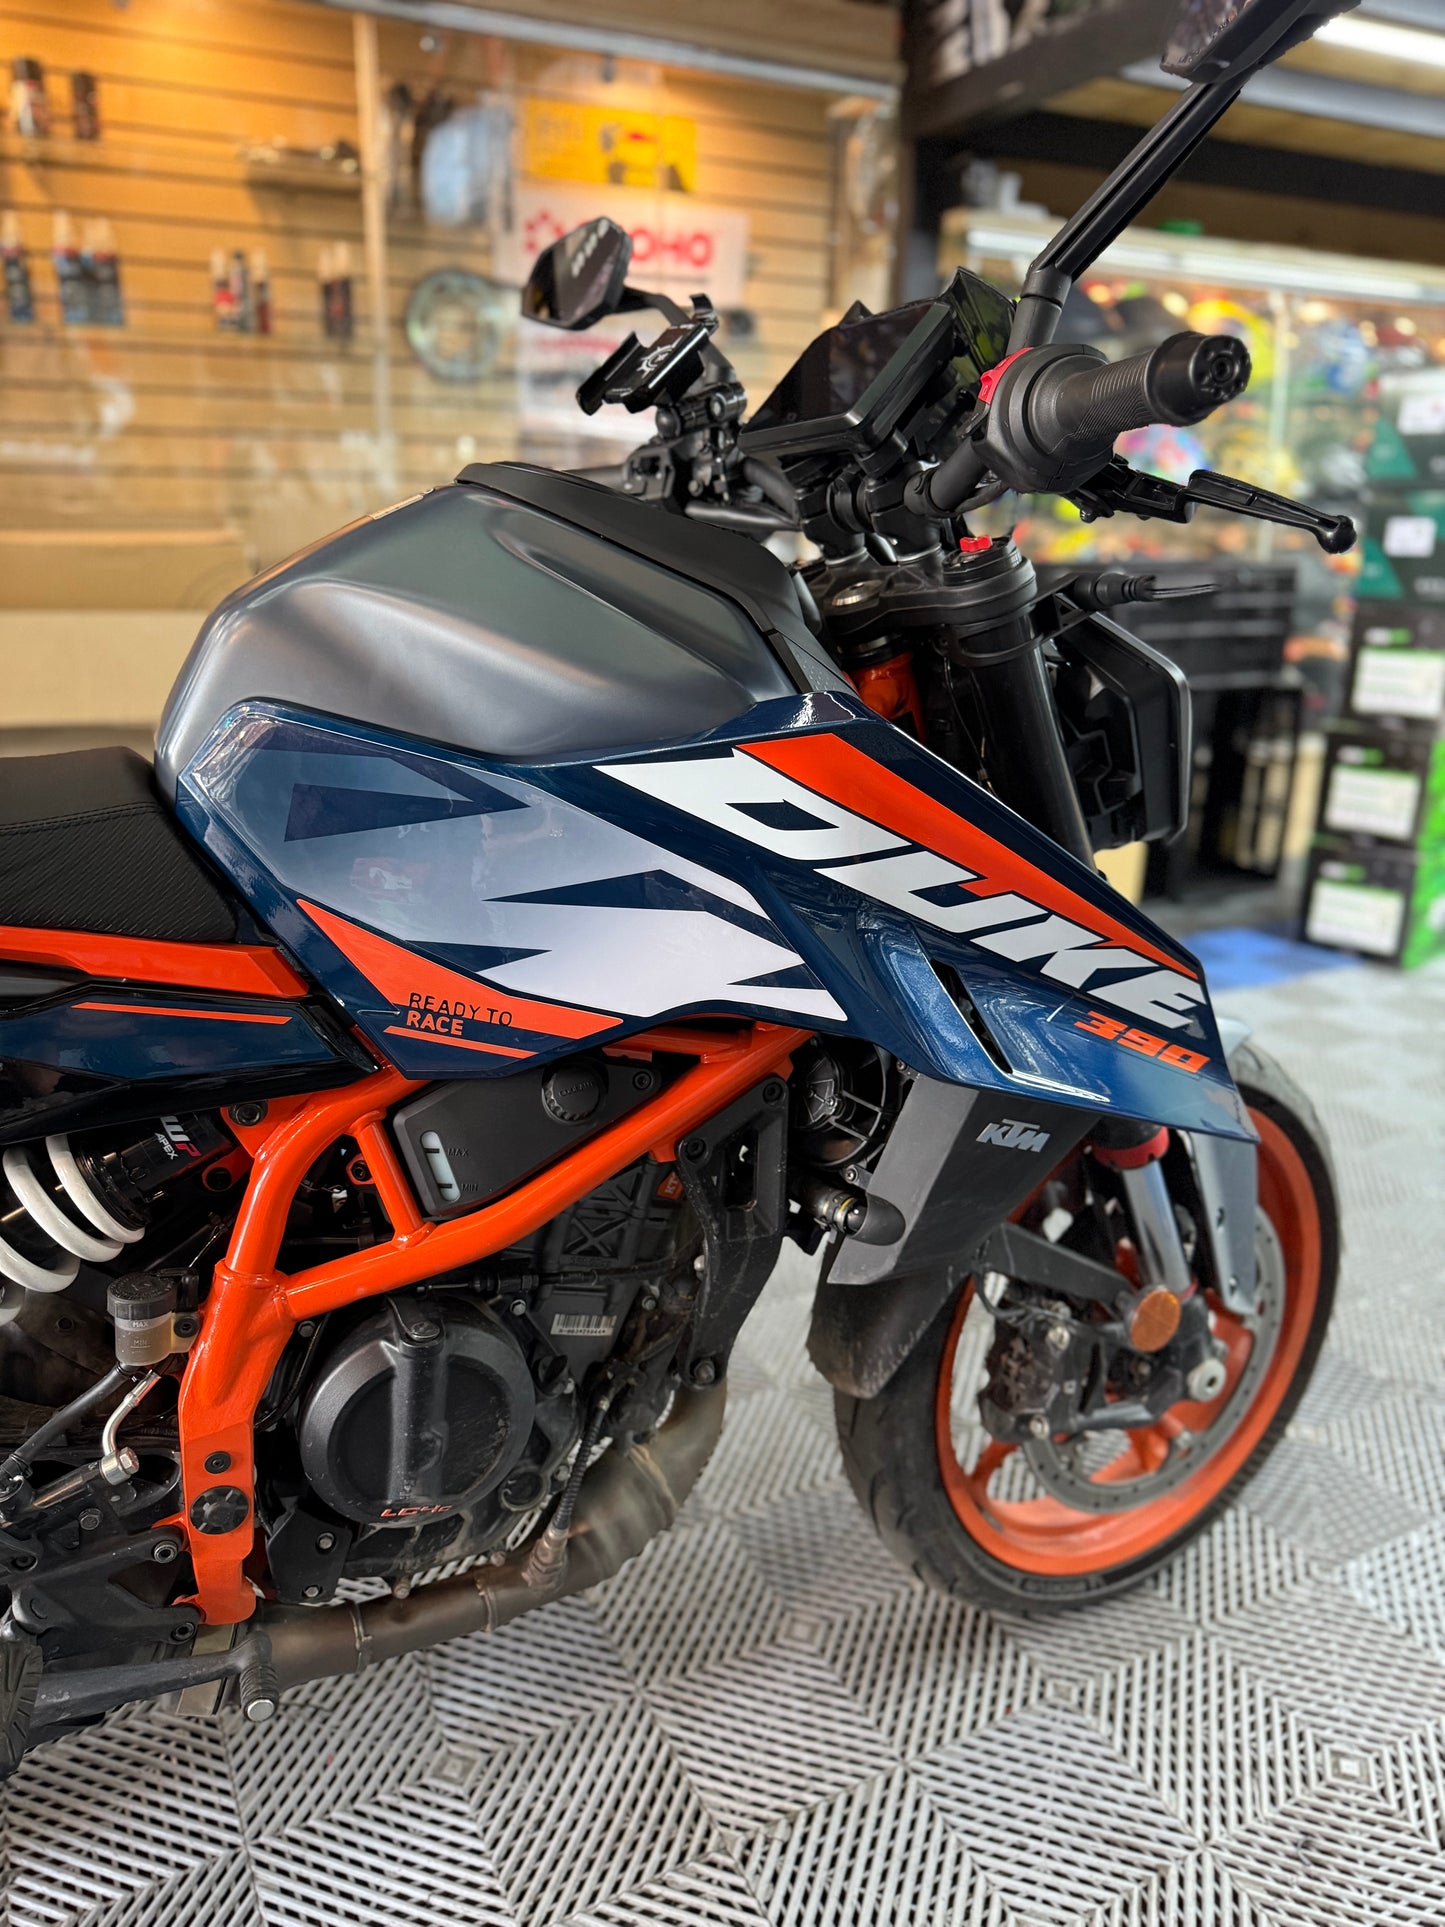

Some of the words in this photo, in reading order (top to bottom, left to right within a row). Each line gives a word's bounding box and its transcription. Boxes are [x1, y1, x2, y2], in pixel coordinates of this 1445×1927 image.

[592, 748, 1207, 1029] DUKE
[406, 1010, 464, 1036] RACE
[409, 992, 481, 1019] READY
[486, 1007, 513, 1026] TO
[1074, 1010, 1211, 1074] 390
[154, 1132, 179, 1160] APEX
[976, 1118, 1051, 1153] KTM
[447, 1147, 470, 1157] MAX
[461, 1183, 479, 1192] MIN
[132, 1320, 149, 1328] MAX
